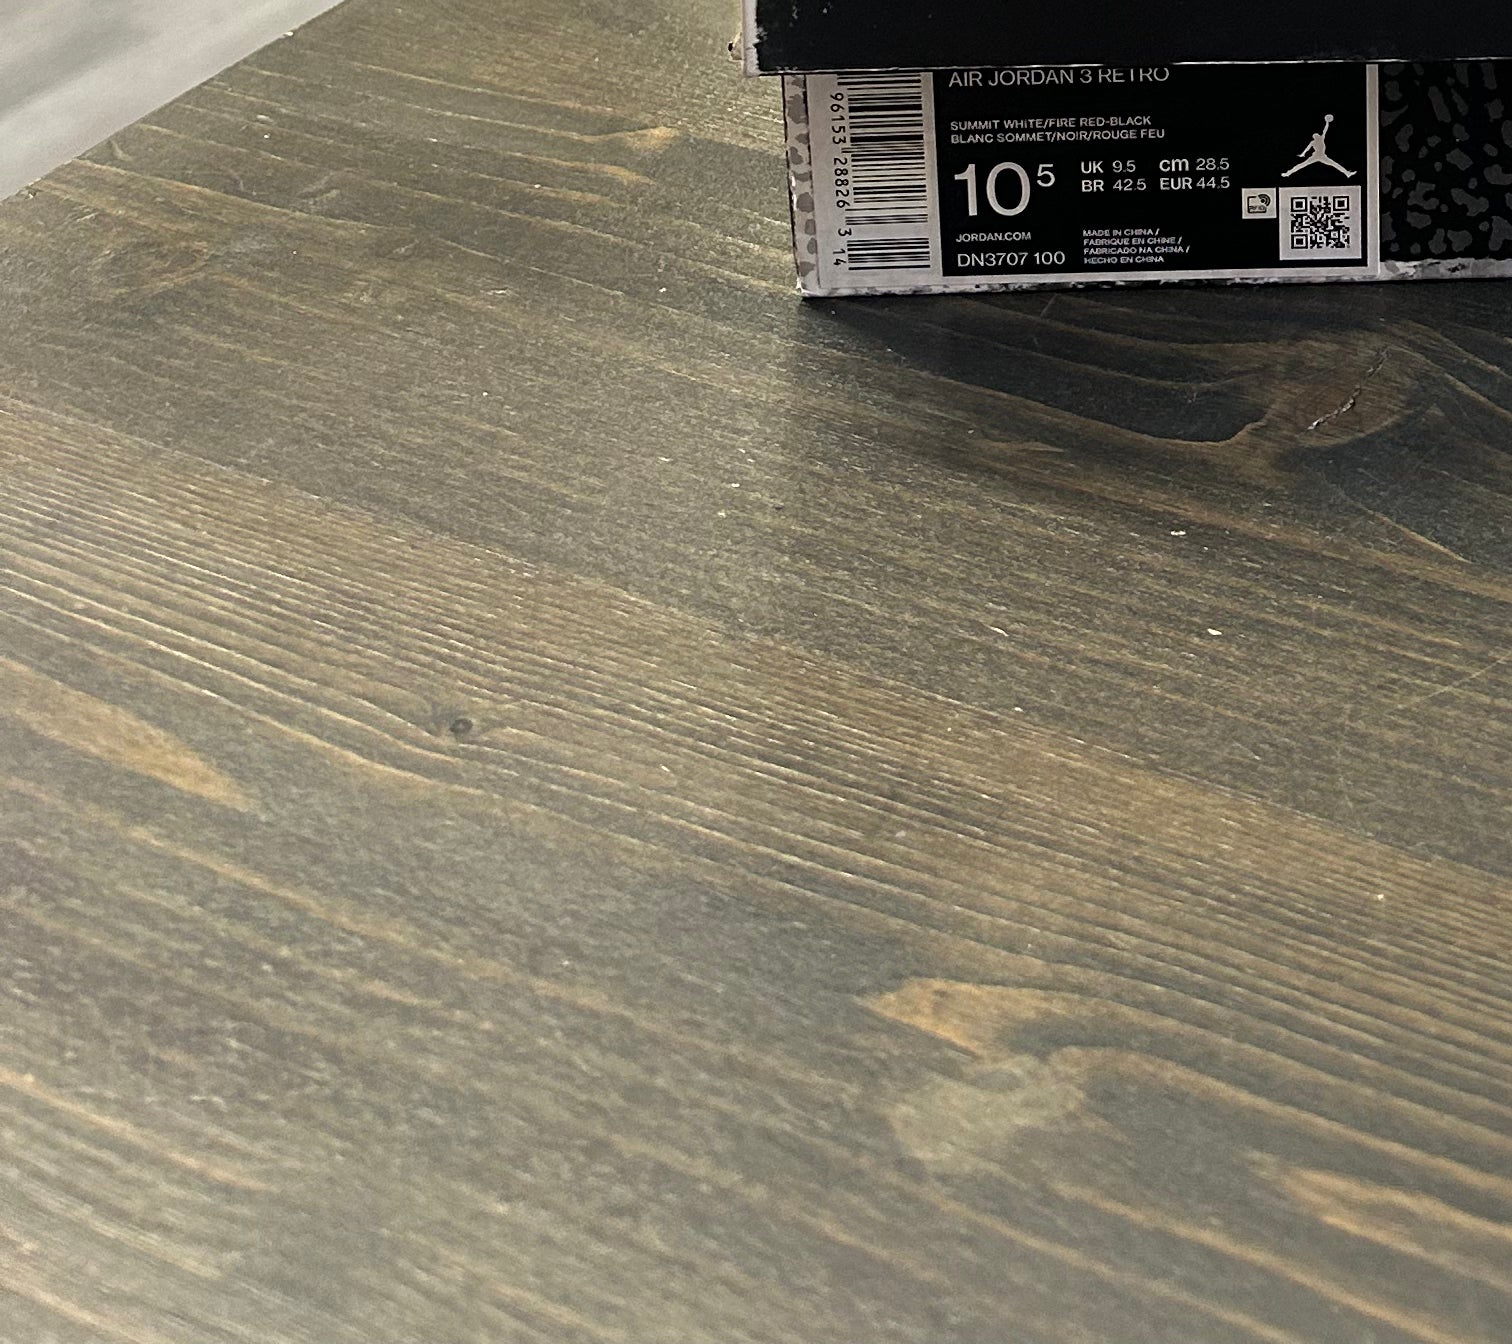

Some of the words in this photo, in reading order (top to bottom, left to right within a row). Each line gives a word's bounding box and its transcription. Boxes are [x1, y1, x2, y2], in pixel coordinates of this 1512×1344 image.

[949, 70, 983, 87] AIR
[988, 68, 1074, 86] JORDAN
[1079, 68, 1093, 84] 3
[830, 92, 847, 145] 96153
[950, 119, 1000, 131] SUMMIT
[1003, 117, 1077, 129] WHITE/FIRE
[1079, 115, 1152, 127] RED-BLACK
[950, 133, 994, 144] BLANC
[996, 130, 1138, 143] SOMMET/NOIR/ROUGE
[1140, 128, 1166, 139] FEU
[1080, 160, 1104, 174] UK
[1112, 159, 1136, 173] 9.5
[1158, 157, 1190, 172] cm
[1195, 157, 1231, 171] 28.5
[833, 157, 851, 208] 28826
[1081, 179, 1105, 192] BR
[1112, 178, 1147, 192] 42.5
[1159, 176, 1193, 191] EUR
[1195, 175, 1231, 190] 44.5
[955, 231, 1032, 243] JORDAN.COM
[1082, 229, 1111, 237] MADE
[1123, 228, 1154, 236] CHINA
[1083, 237, 1130, 246] FABRIQUE
[1131, 237, 1145, 245] EN
[1083, 246, 1138, 255] FABRICADO
[1138, 246, 1154, 254] NA
[1154, 245, 1184, 253] CHINA
[957, 251, 1029, 268] DN3707
[1033, 250, 1067, 265] 100
[1083, 256, 1118, 264] HECHO
[1119, 255, 1134, 263] EN
[1134, 254, 1165, 263] CHINA
